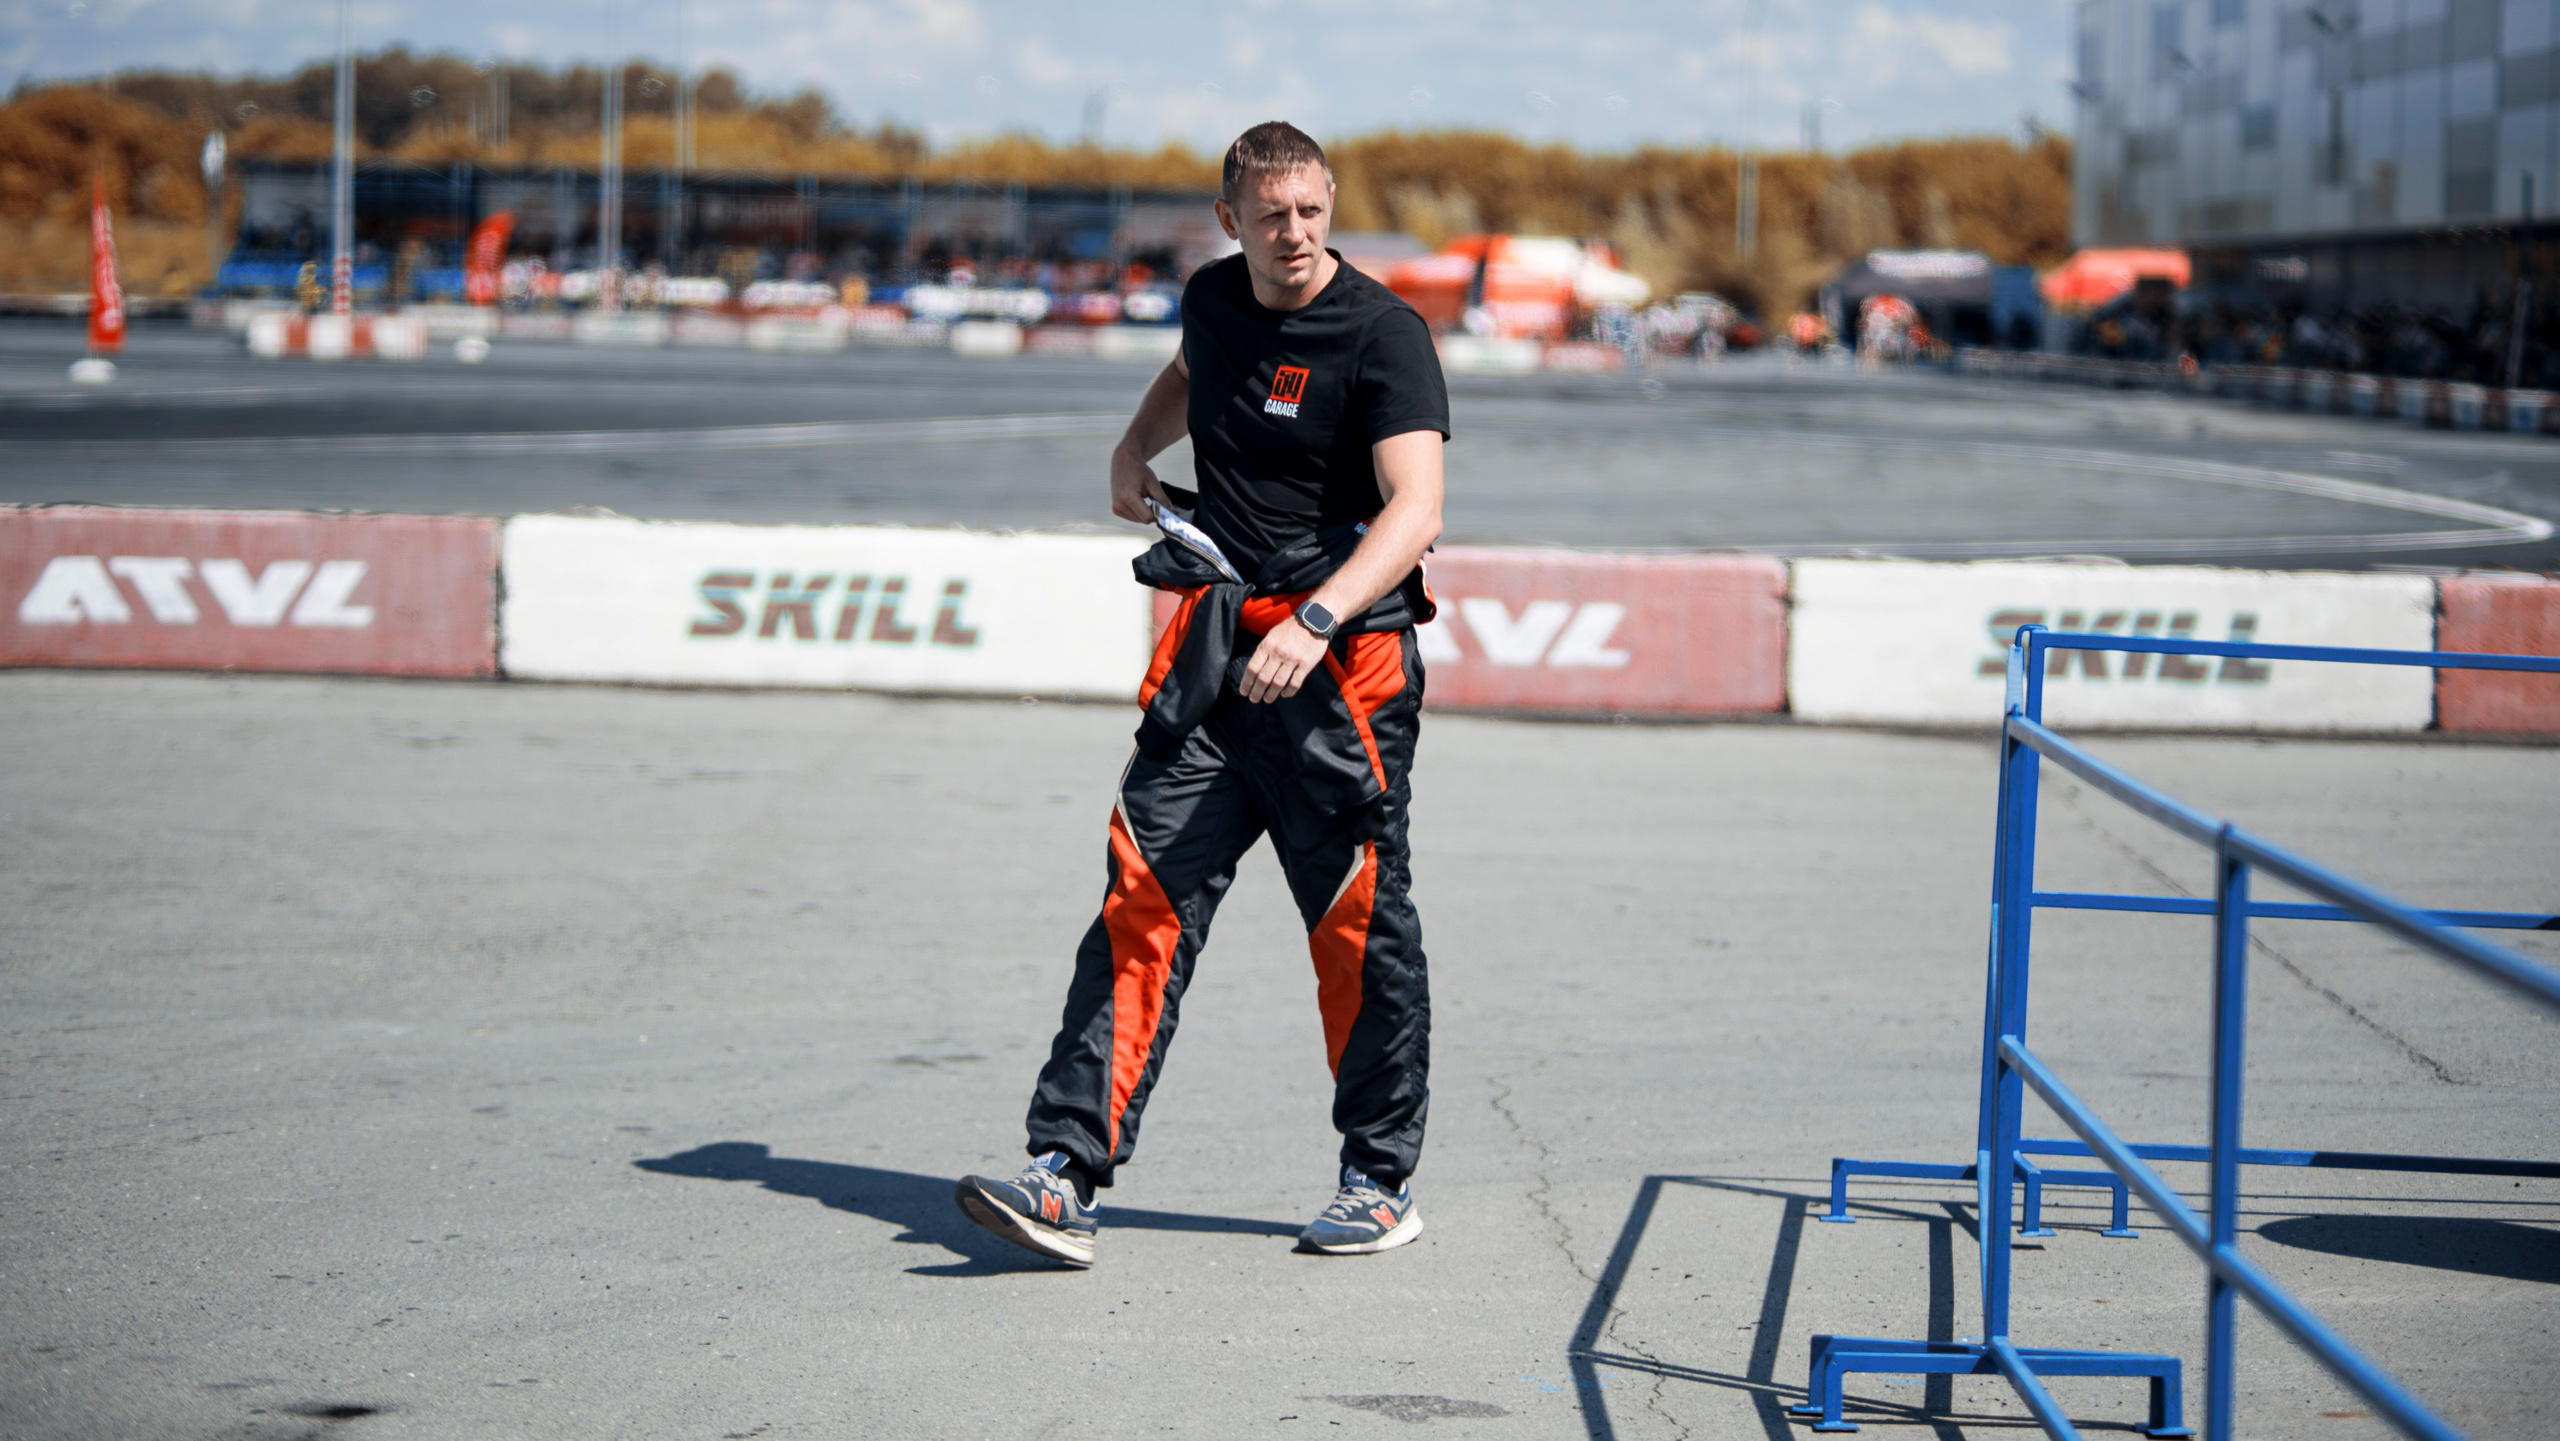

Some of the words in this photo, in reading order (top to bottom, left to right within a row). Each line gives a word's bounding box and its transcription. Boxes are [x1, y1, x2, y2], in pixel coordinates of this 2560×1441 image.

[1264, 398, 1300, 418] GARAGE
[18, 554, 376, 628] ATVL
[688, 573, 979, 647] SKILL
[1041, 1189, 1062, 1224] N
[1369, 1203, 1399, 1231] N
